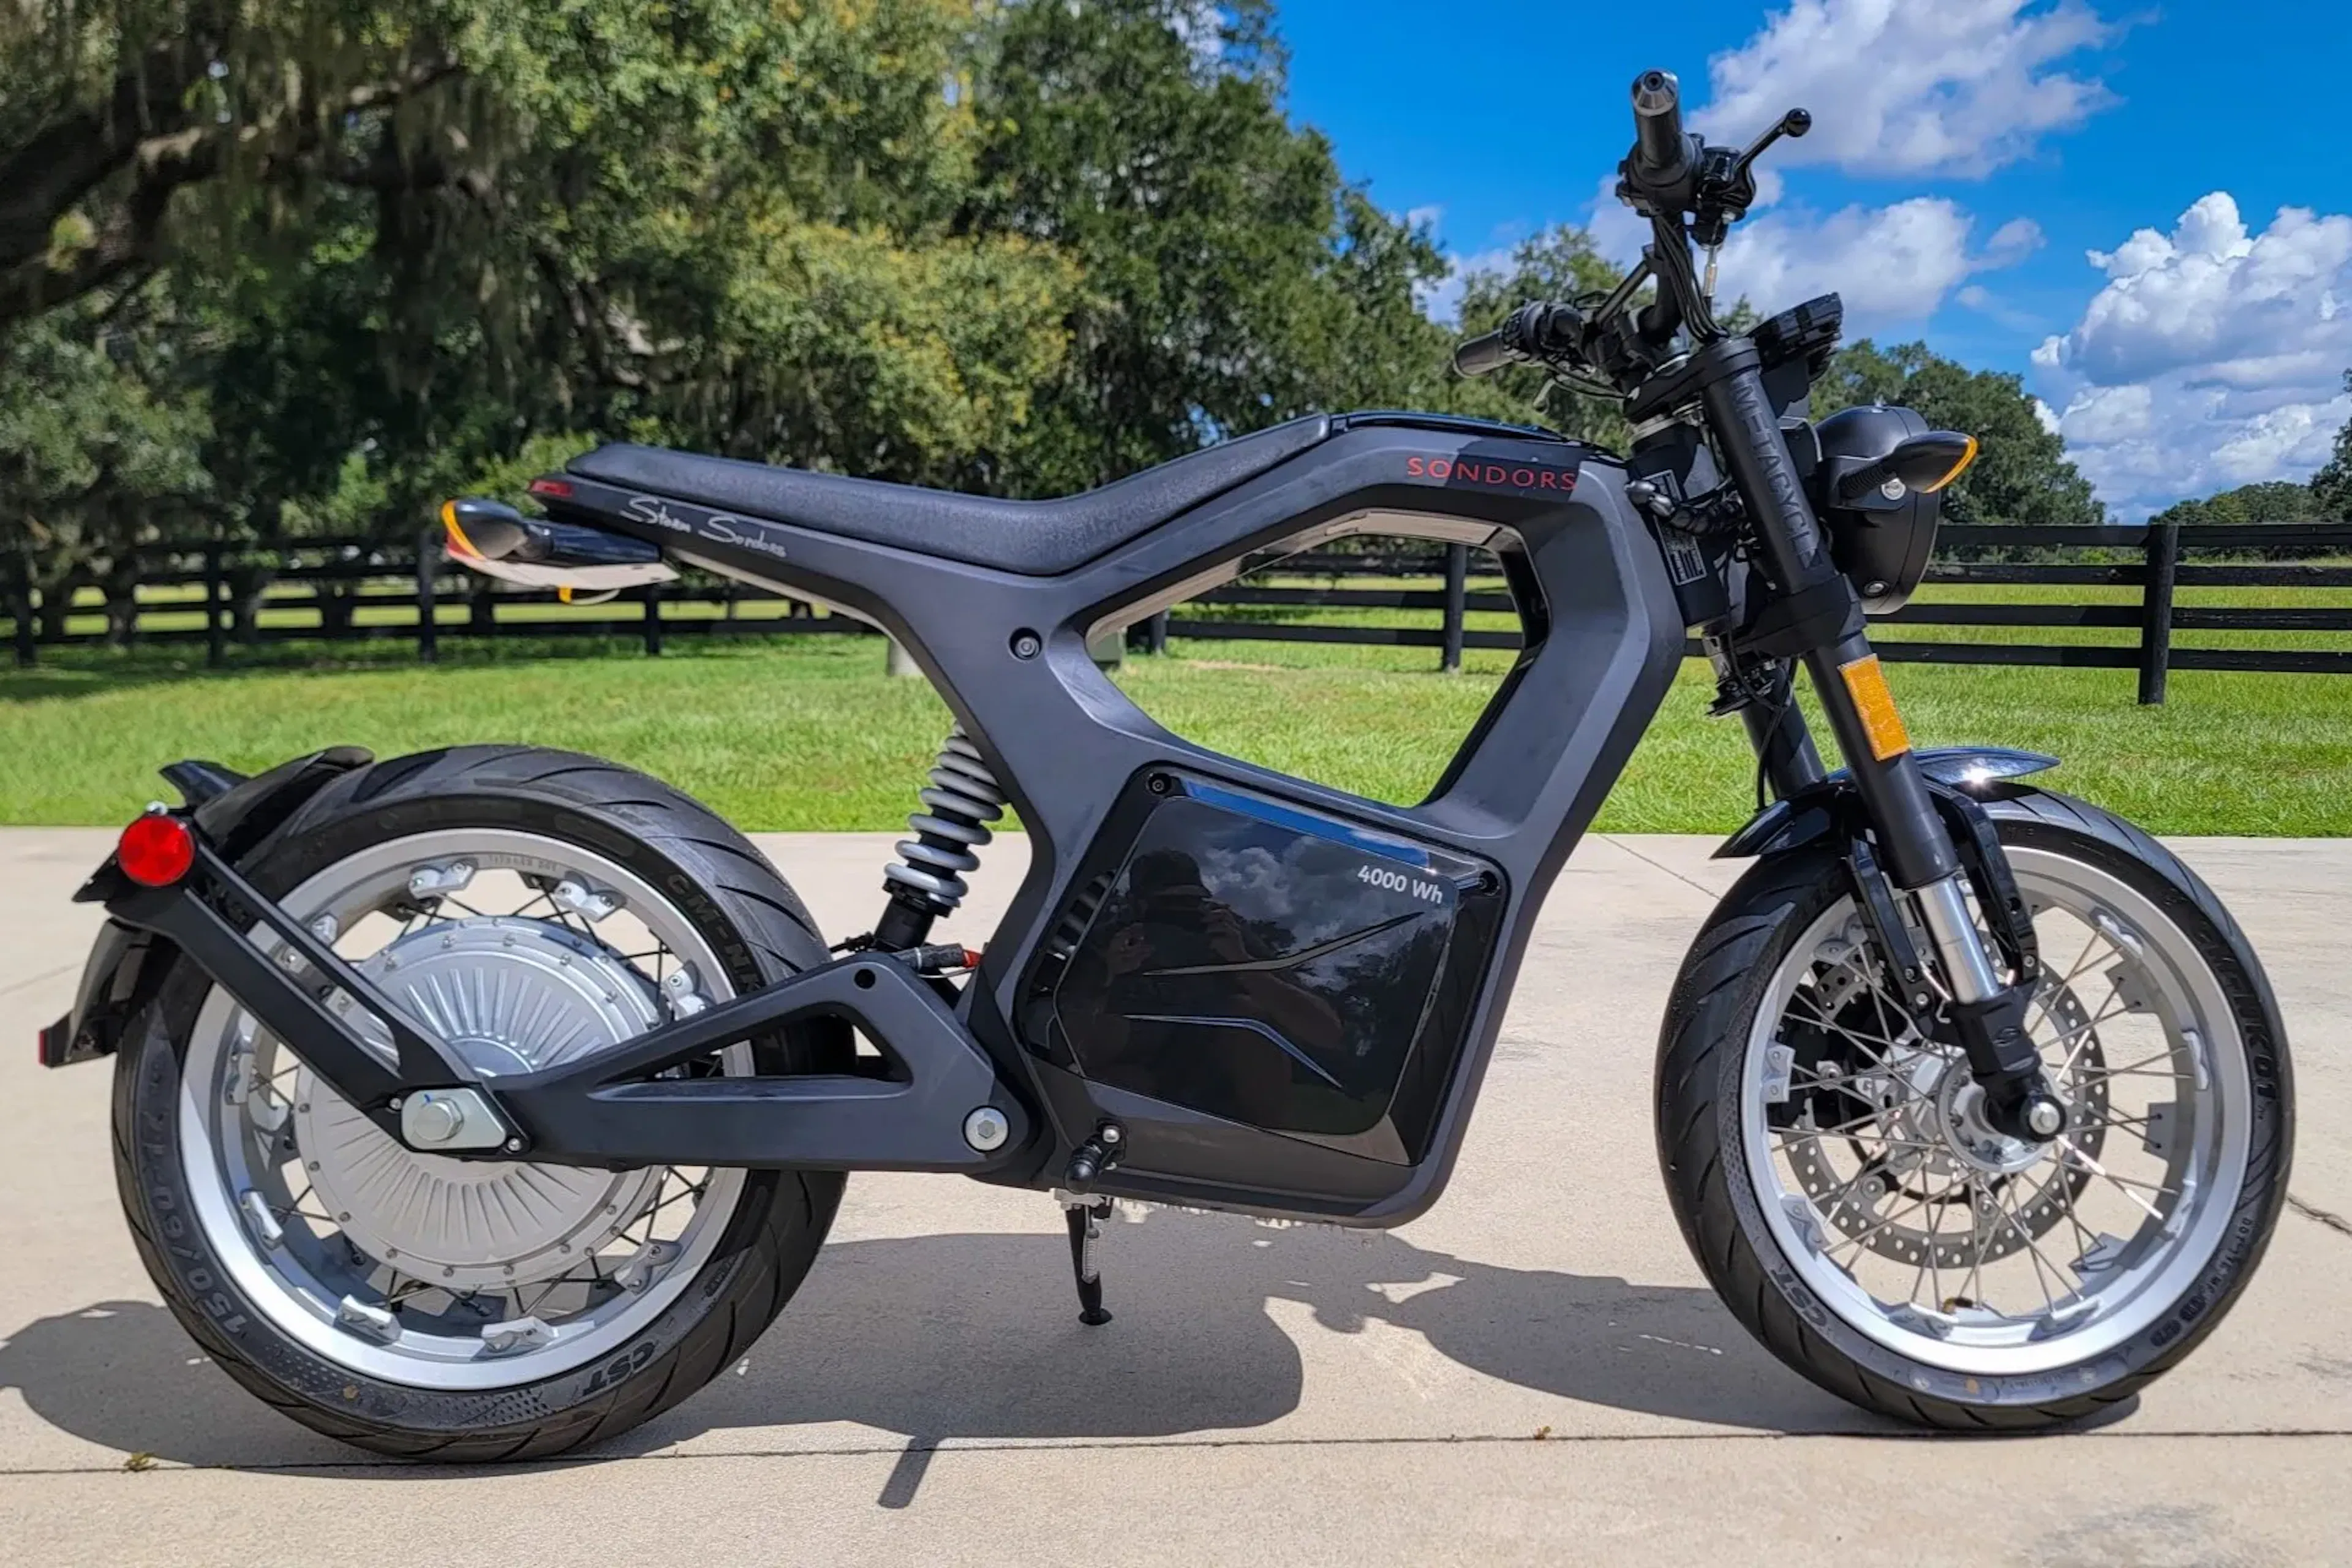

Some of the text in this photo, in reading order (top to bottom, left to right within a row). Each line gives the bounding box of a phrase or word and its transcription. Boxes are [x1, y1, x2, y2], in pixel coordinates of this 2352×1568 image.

[1406, 457, 1578, 491] SONDORS
[1733, 382, 1822, 570] METACYCLE
[1357, 864, 1443, 903] 4000 Wh
[1771, 1268, 1827, 1327] CST
[582, 1341, 657, 1396] CST
